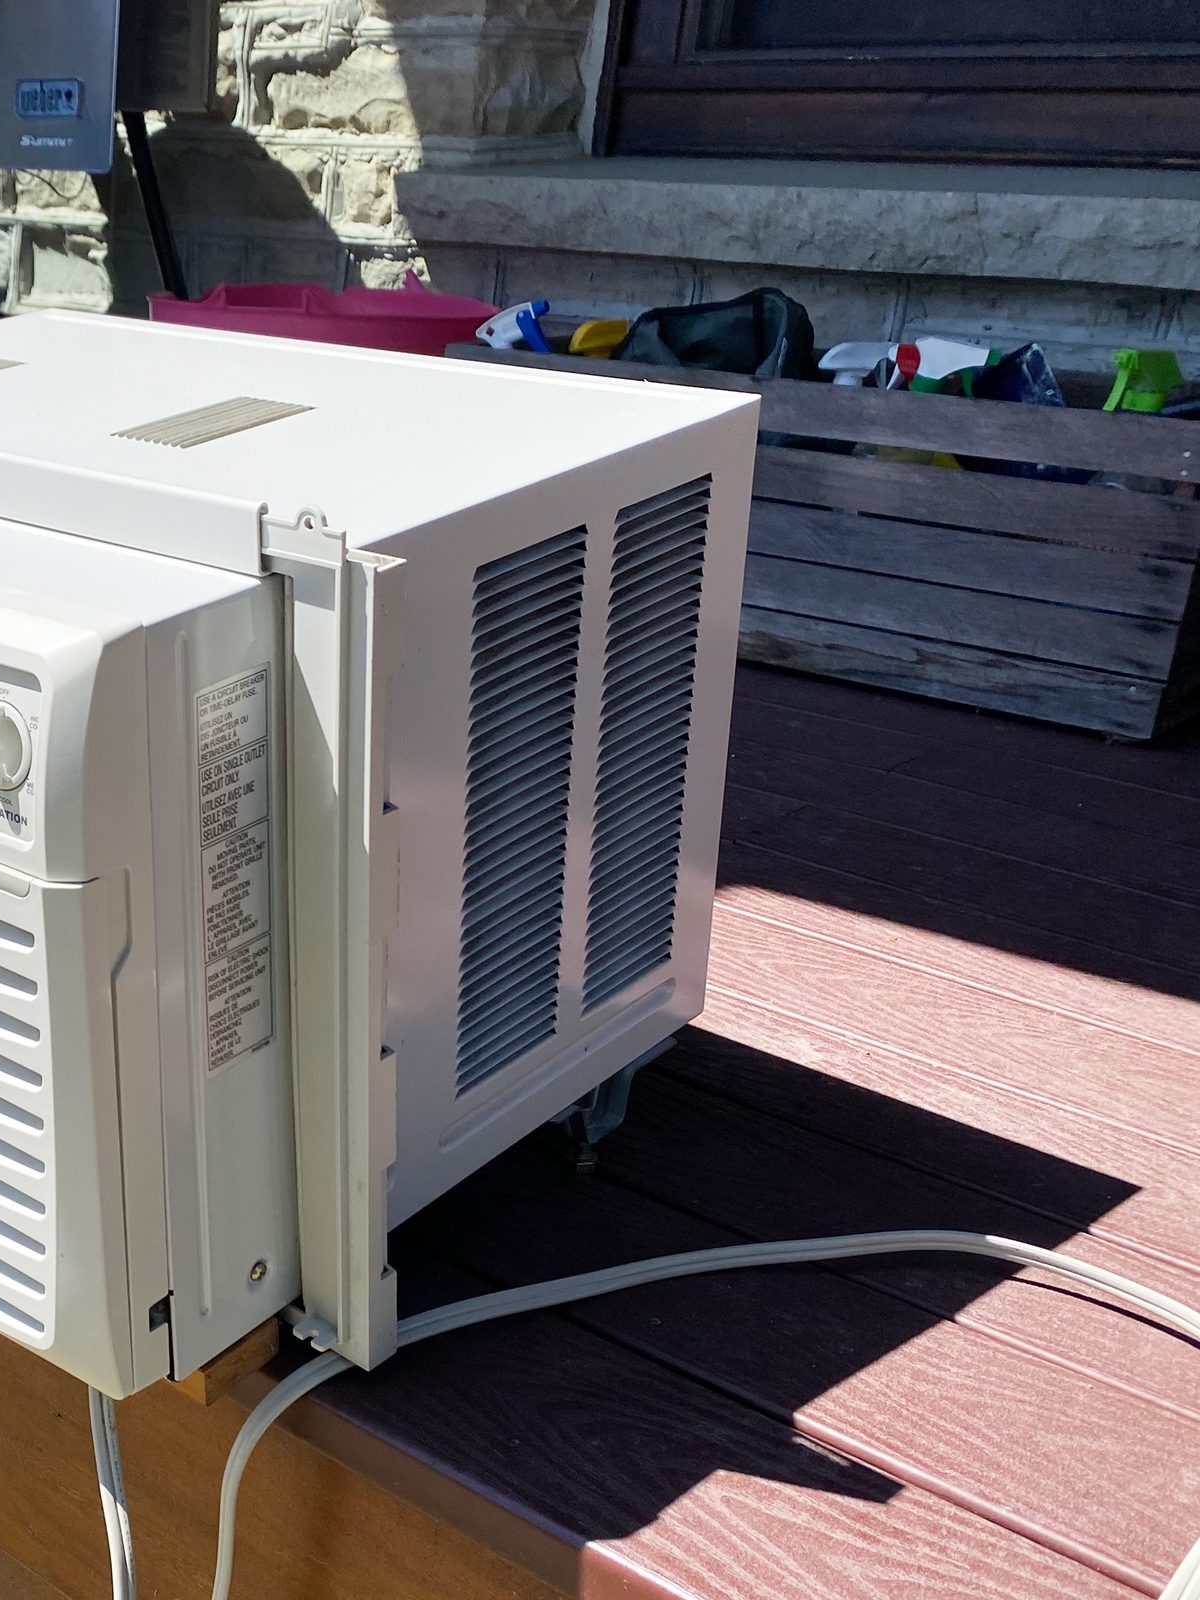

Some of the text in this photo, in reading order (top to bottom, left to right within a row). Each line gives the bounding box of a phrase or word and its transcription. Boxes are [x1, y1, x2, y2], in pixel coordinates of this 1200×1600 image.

[200, 698, 210, 707] USE
[217, 684, 238, 699] CIRCUIT
[240, 673, 264, 689] BREAKER
[200, 708, 208, 717] OR
[209, 695, 241, 712] TIME-DELAY
[200, 711, 232, 731] UTILISEZ UN
[240, 714, 248, 724] OU
[201, 742, 209, 751] UN
[210, 732, 232, 747] FUSIBLE
[201, 744, 266, 782] USE ON SINGLE OUTLET
[202, 777, 224, 796] CIRCUIT
[202, 780, 255, 814] UTILISEZ AVEC UNE
[203, 802, 238, 828] SEULE PRISE
[225, 832, 248, 848] CAUTION
[208, 841, 266, 875] DO NOT OPERATE UNIT
[217, 846, 238, 861] MOVING
[211, 851, 263, 881] WITH FRONT GRILLE
[223, 880, 251, 898] ATTENTION
[207, 902, 241, 924] NE PAS FAIRE
[239, 914, 253, 926] AVEC
[208, 920, 258, 951] LE GRILLAGE AVANT
[208, 947, 269, 983] RISK OF ELECTRIC SHOCK
[227, 948, 250, 963] CAUTION
[208, 961, 258, 992] DISCONNECT POWER
[208, 965, 266, 1002] BEFORE SERVICING UNIT
[225, 986, 252, 1004] ATTENTION
[209, 1002, 238, 1021] RISQUES DE
[211, 1044, 227, 1058] AVANT
[235, 1036, 241, 1045] LE
